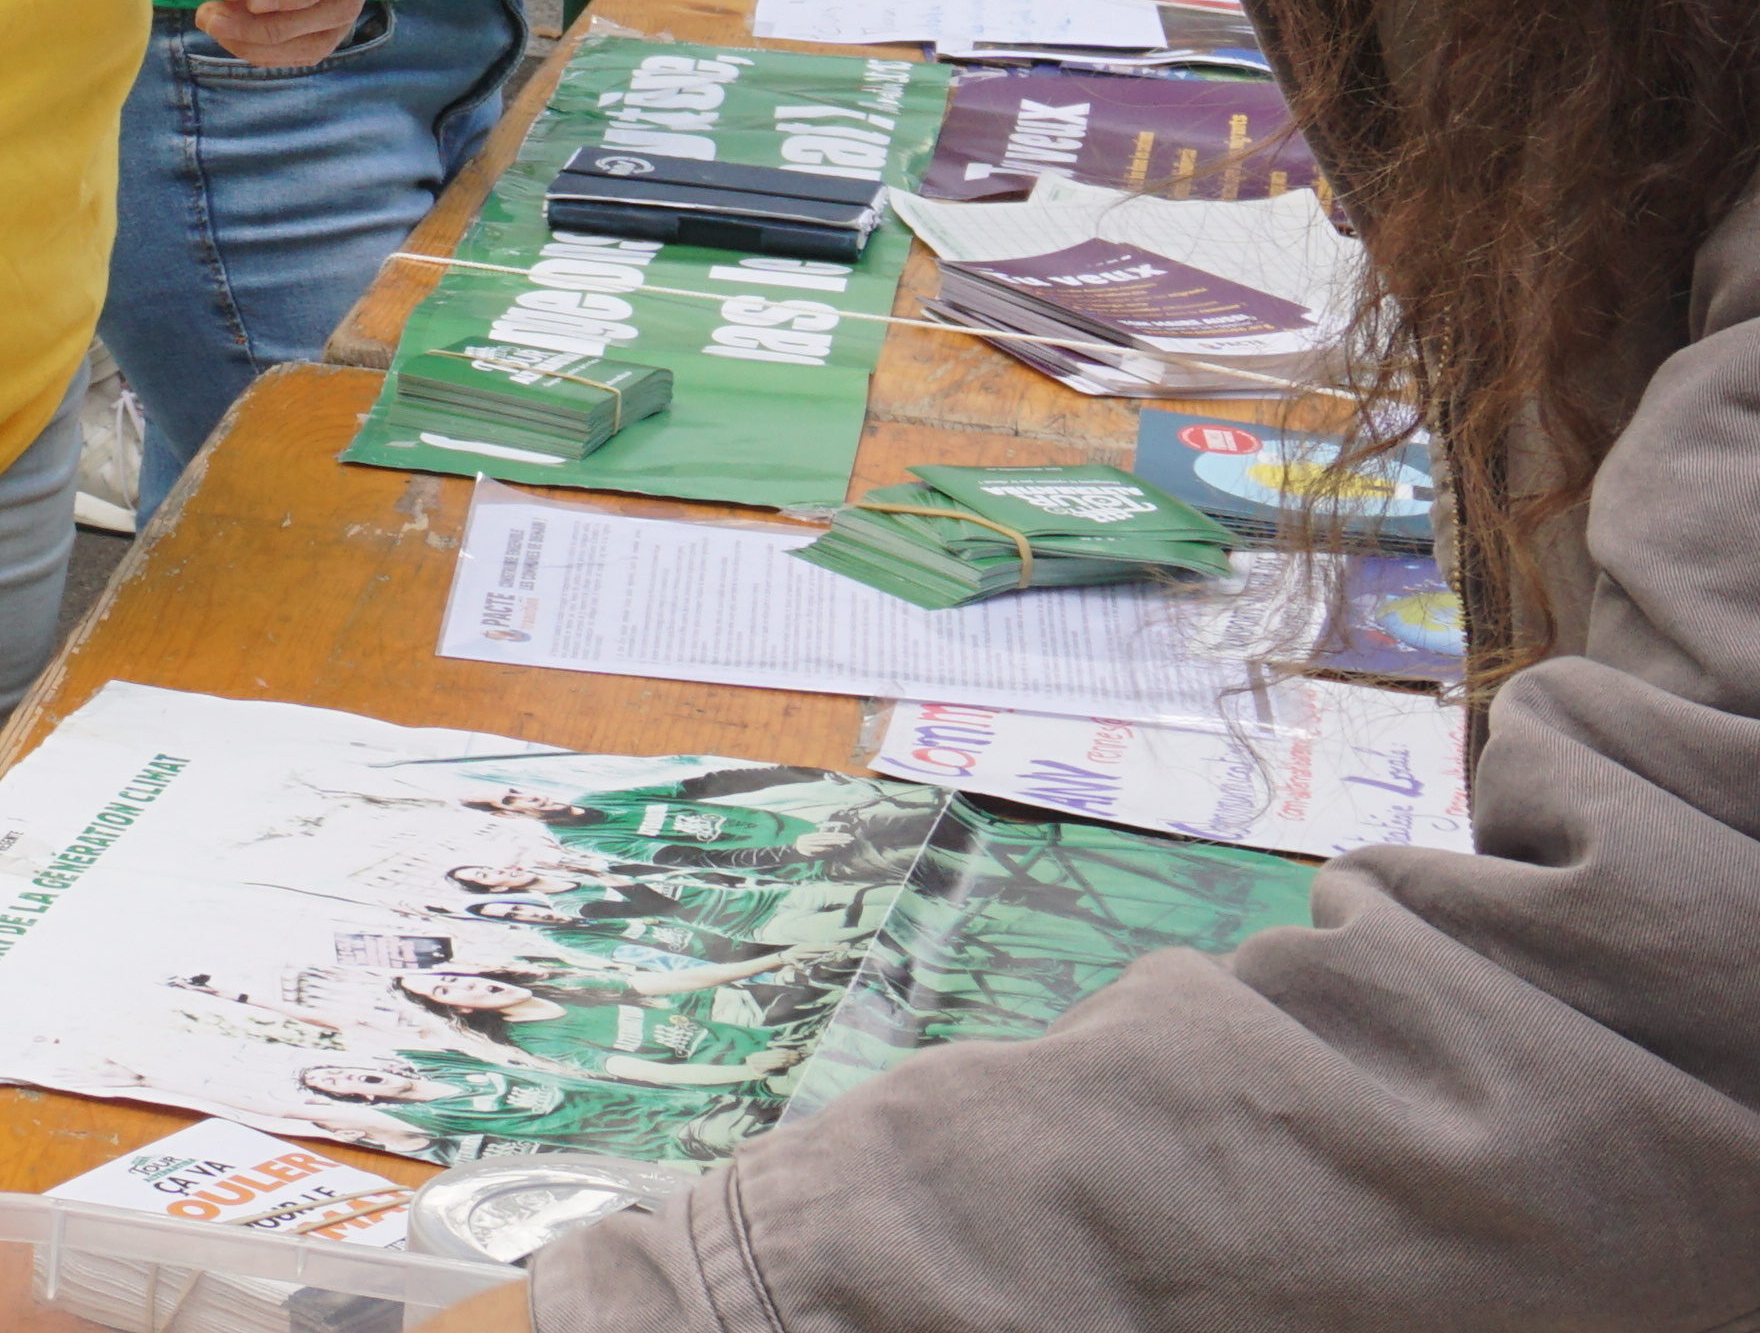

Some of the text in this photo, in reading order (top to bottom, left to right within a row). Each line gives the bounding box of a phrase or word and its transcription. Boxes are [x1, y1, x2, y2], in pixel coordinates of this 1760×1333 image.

[1048, 262, 1169, 287] veux
[118, 753, 192, 803] CLIMAT
[31, 802, 146, 890] GÉNÉRATION
[8, 892, 60, 914] LA
[166, 1152, 342, 1222] OULER
[184, 1160, 236, 1177] VA
